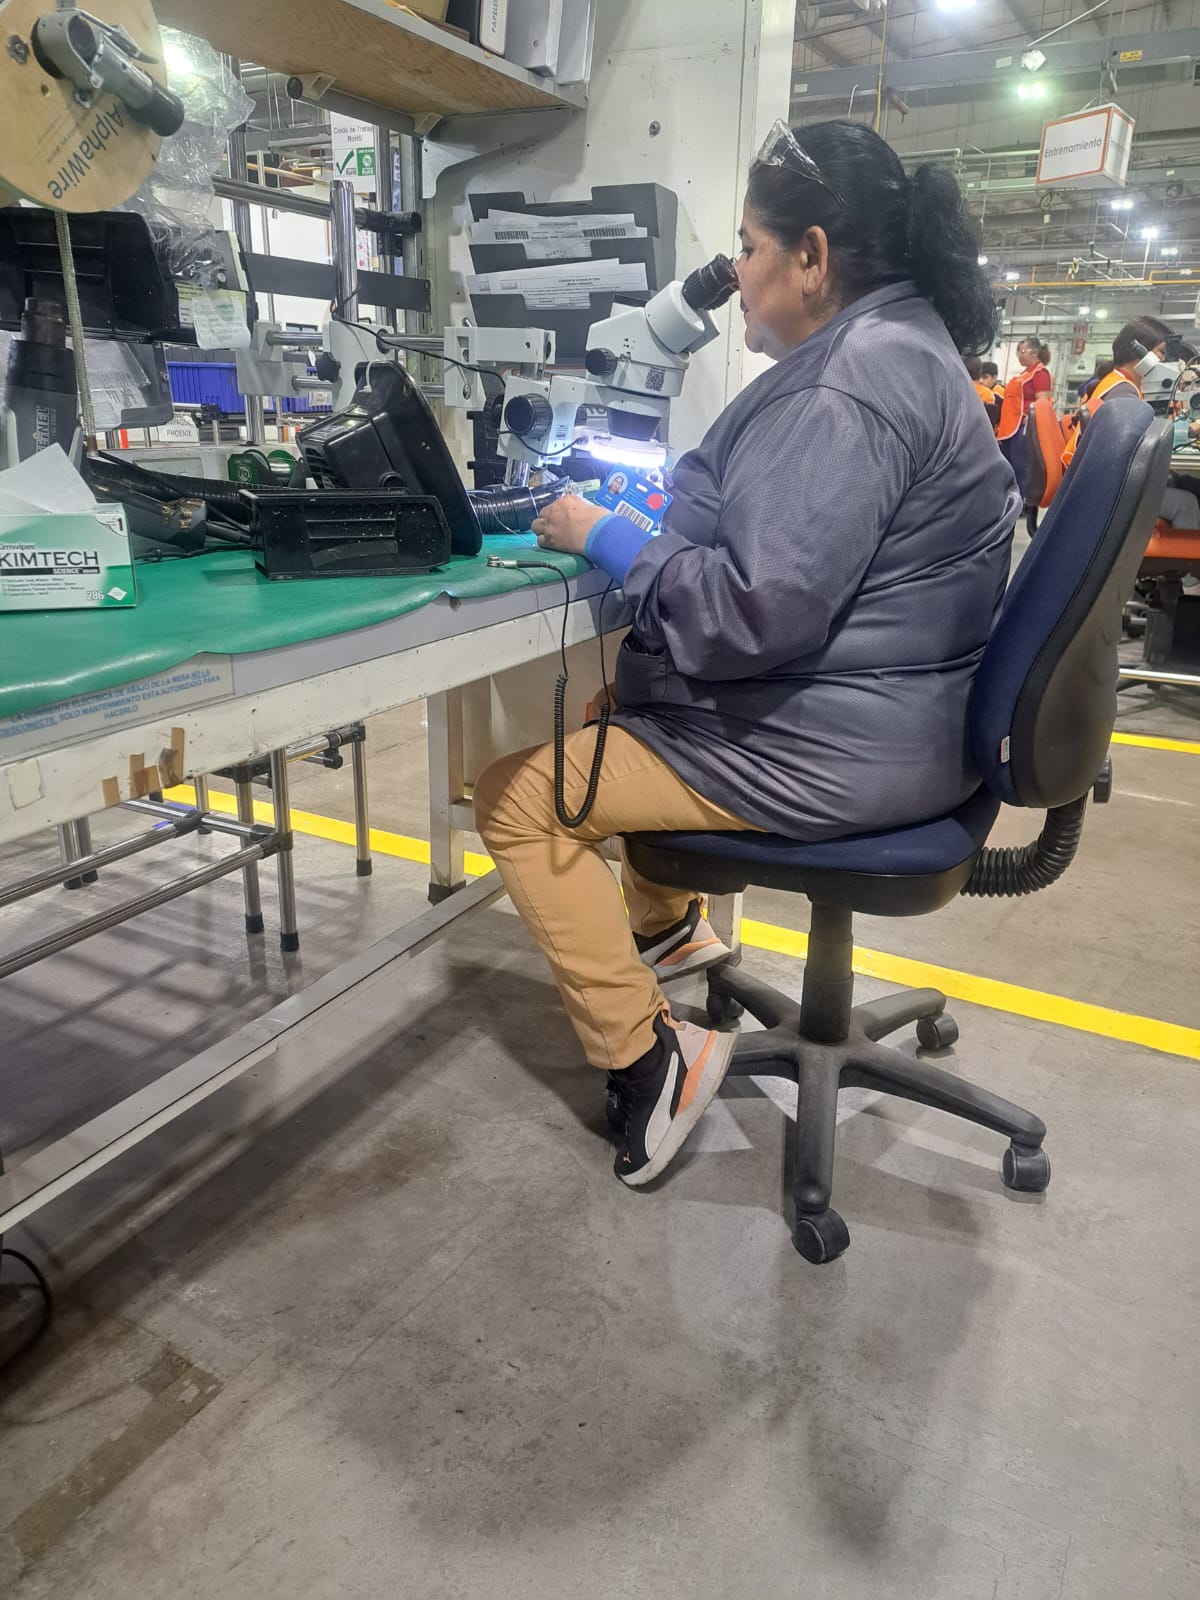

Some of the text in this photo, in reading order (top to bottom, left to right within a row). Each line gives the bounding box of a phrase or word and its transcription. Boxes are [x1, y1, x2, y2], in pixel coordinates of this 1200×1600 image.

[47, 103, 127, 200] AlphaWire
[1044, 137, 1102, 158] Entrenamiento
[166, 429, 192, 438] PHOENIX
[117, 517, 123, 531] 1
[0, 551, 99, 567] KIMTECH
[58, 709, 81, 721] SOLO
[81, 695, 141, 714] MANTENIMIENTO
[142, 689, 160, 701] ESTA
[160, 679, 202, 696] AUTORIZADO
[71, 691, 113, 709] ELECTRICA
[114, 688, 125, 697] DE
[126, 682, 150, 694] ABAJO
[151, 680, 161, 688] DE
[161, 677, 171, 686] LA
[171, 673, 190, 683] MESA
[103, 704, 138, 720] HACERLO
